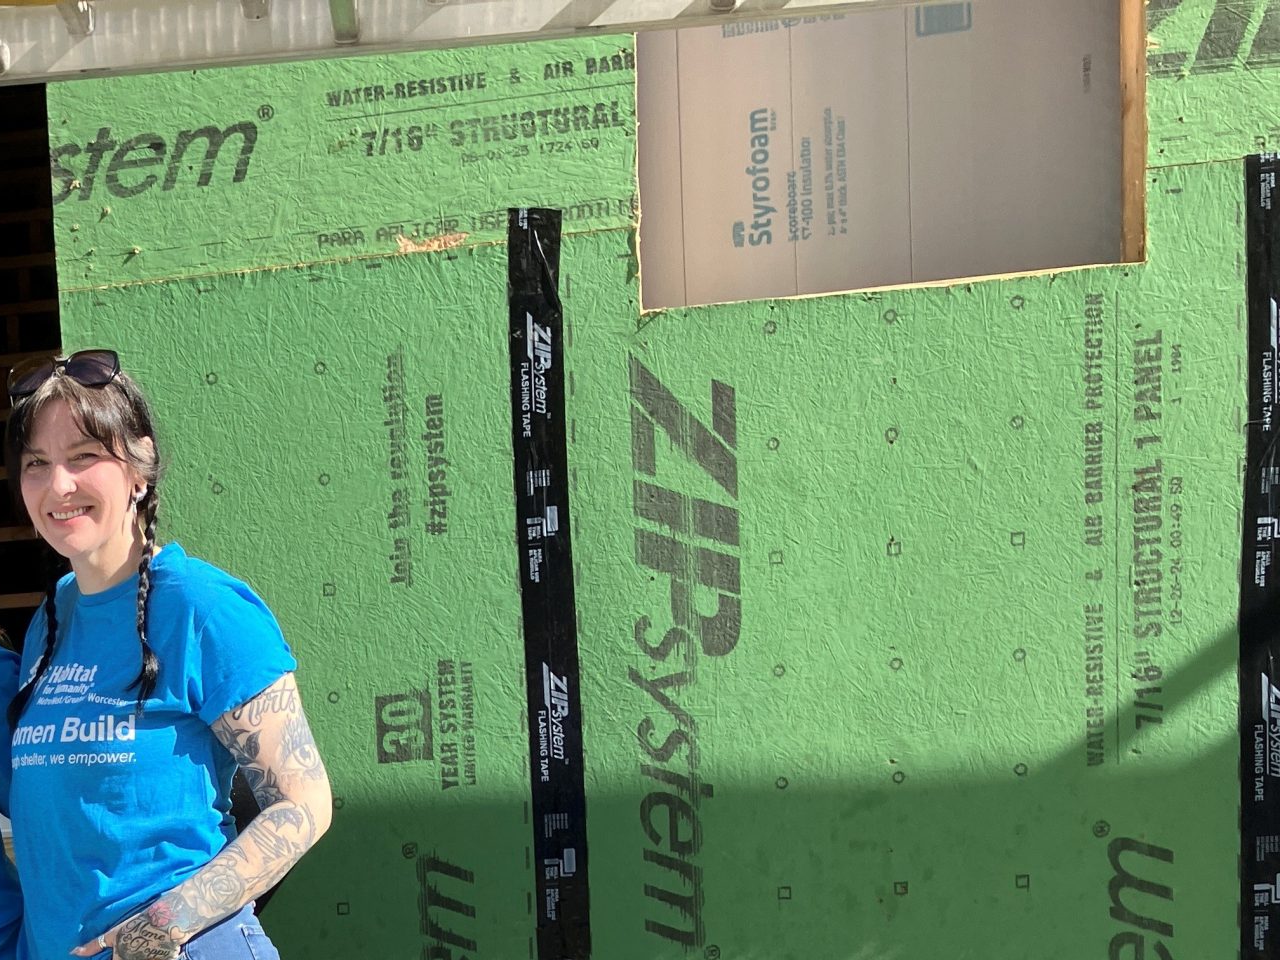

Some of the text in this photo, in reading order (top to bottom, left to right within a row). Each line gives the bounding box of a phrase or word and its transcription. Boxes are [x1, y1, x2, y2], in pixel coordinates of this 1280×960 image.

[325, 72, 488, 108] WATER-RESISTIVE
[543, 60, 574, 81] AIR
[449, 101, 624, 148] STRUCTURAL
[745, 107, 778, 246] Styrofoam
[319, 230, 365, 247] PARA
[1083, 293, 1104, 410] PROTECTION
[1133, 329, 1163, 422] PANEL
[1262, 352, 1272, 432] FLASHING TAPE
[520, 362, 532, 438] FLASHING TAPE
[382, 353, 409, 586] Join the revolution
[422, 393, 453, 536] #zipsystem
[1084, 421, 1104, 505] BARRIER
[1084, 515, 1104, 547] AIR
[1133, 458, 1164, 639] STRUCTURAL
[437, 659, 459, 790] YEAR SYSTEM
[460, 661, 476, 785] LIMITED WARRANTY
[1083, 603, 1105, 768] WATER-RESISTIVE
[12, 715, 136, 746] omen Build
[21, 754, 48, 768] shelter,
[50, 754, 65, 765] we
[68, 752, 137, 768] empower.
[538, 710, 550, 782] FLASHING TAPE
[1254, 724, 1264, 802] FLASHING TAPE
